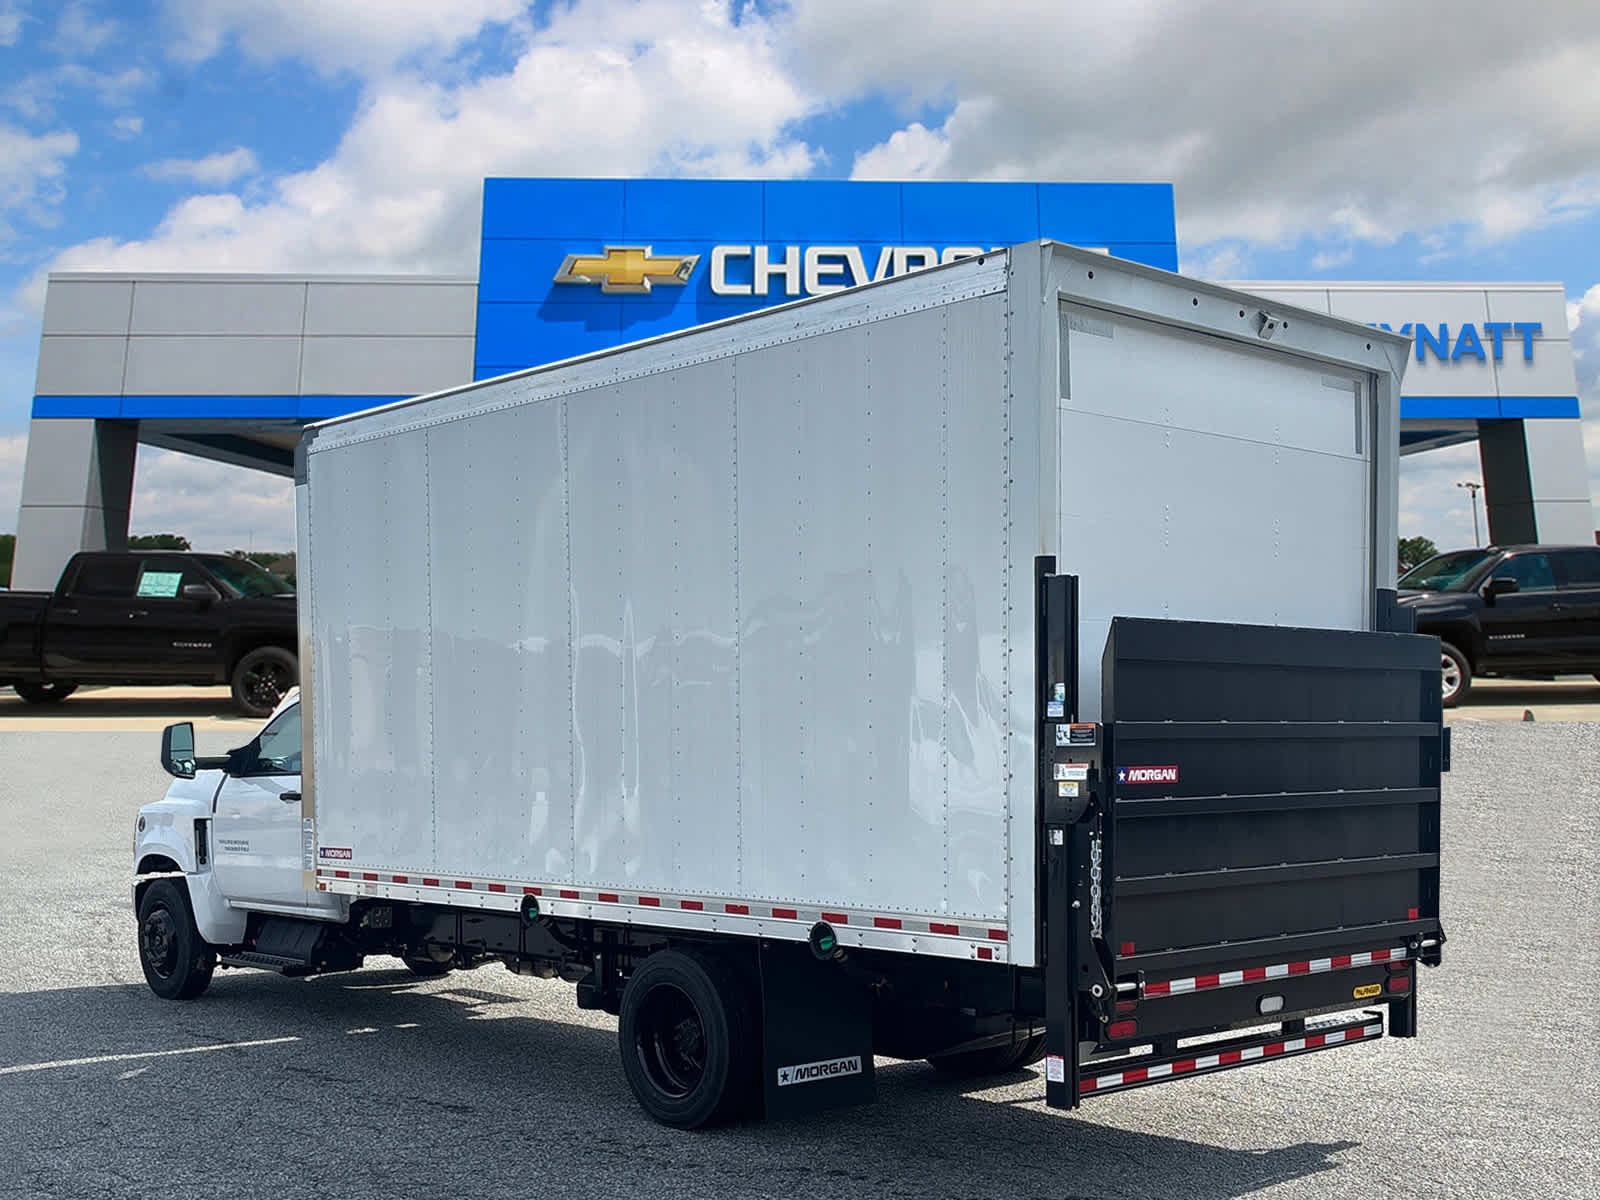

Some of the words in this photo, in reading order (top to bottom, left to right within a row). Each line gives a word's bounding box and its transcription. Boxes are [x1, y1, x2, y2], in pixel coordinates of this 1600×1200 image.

[1366, 321, 1542, 361] NATT
[1128, 768, 1177, 781] MORGAN
[795, 1059, 858, 1081] MORGAN
